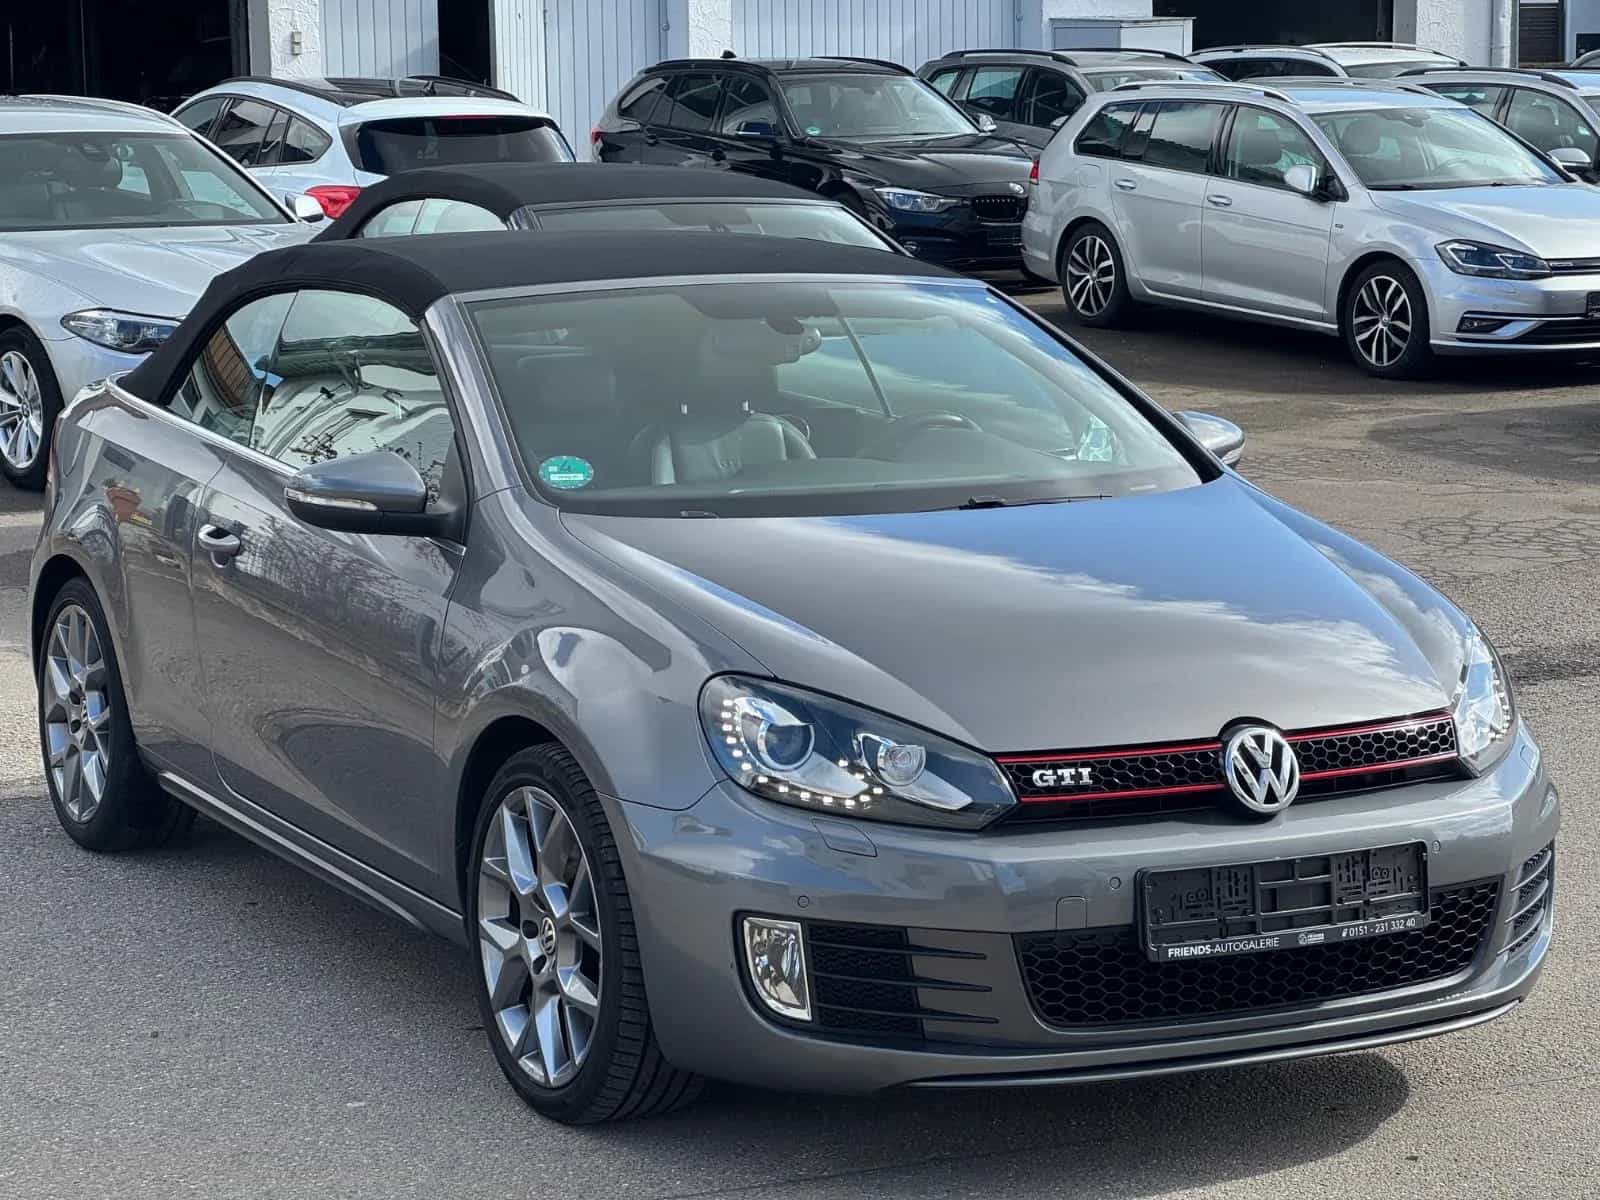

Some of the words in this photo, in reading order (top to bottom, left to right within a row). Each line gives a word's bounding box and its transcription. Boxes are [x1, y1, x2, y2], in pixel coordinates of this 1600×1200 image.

[1032, 767, 1093, 787] GTI
[1349, 926, 1368, 937] 0151
[1375, 922, 1389, 933] 231
[1391, 920, 1405, 931] 332
[1406, 918, 1416, 928] 40
[1168, 937, 1280, 958] FRIENDS-AUTOGALERIE
